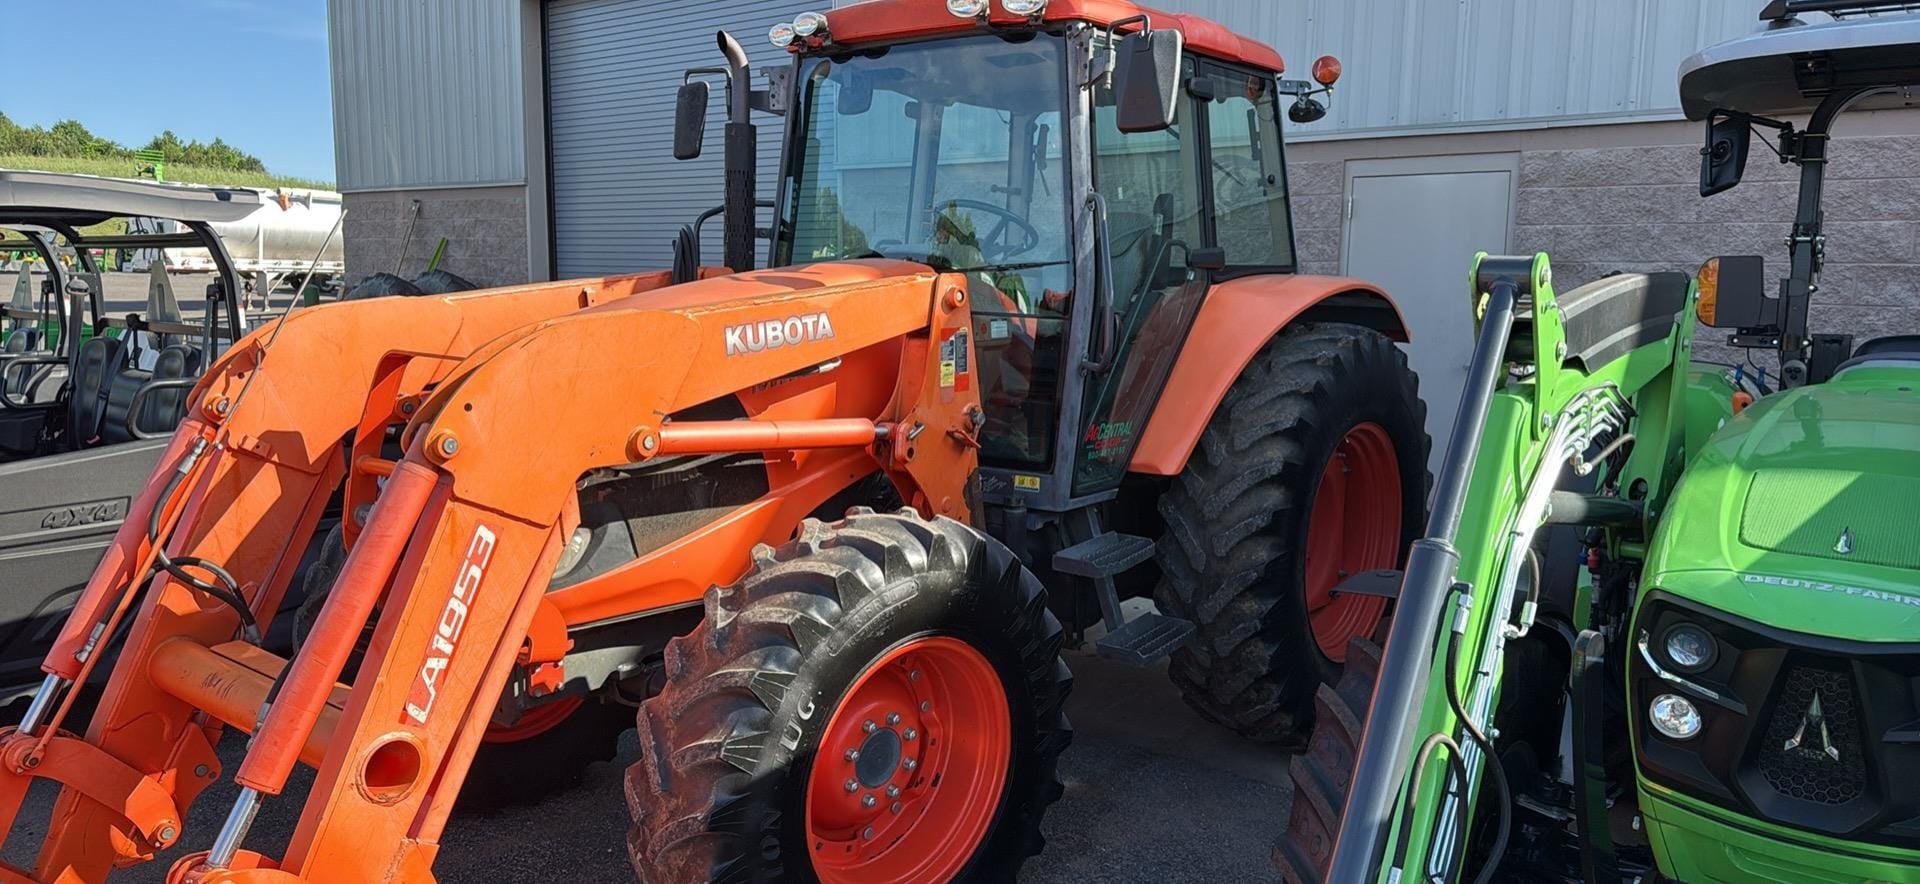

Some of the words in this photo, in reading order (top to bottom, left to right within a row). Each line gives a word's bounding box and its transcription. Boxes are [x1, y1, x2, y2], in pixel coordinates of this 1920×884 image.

[724, 311, 834, 356] KUBOTA
[1744, 574, 1920, 606] DEUTZ-FAHR
[406, 524, 495, 724] LA1953
